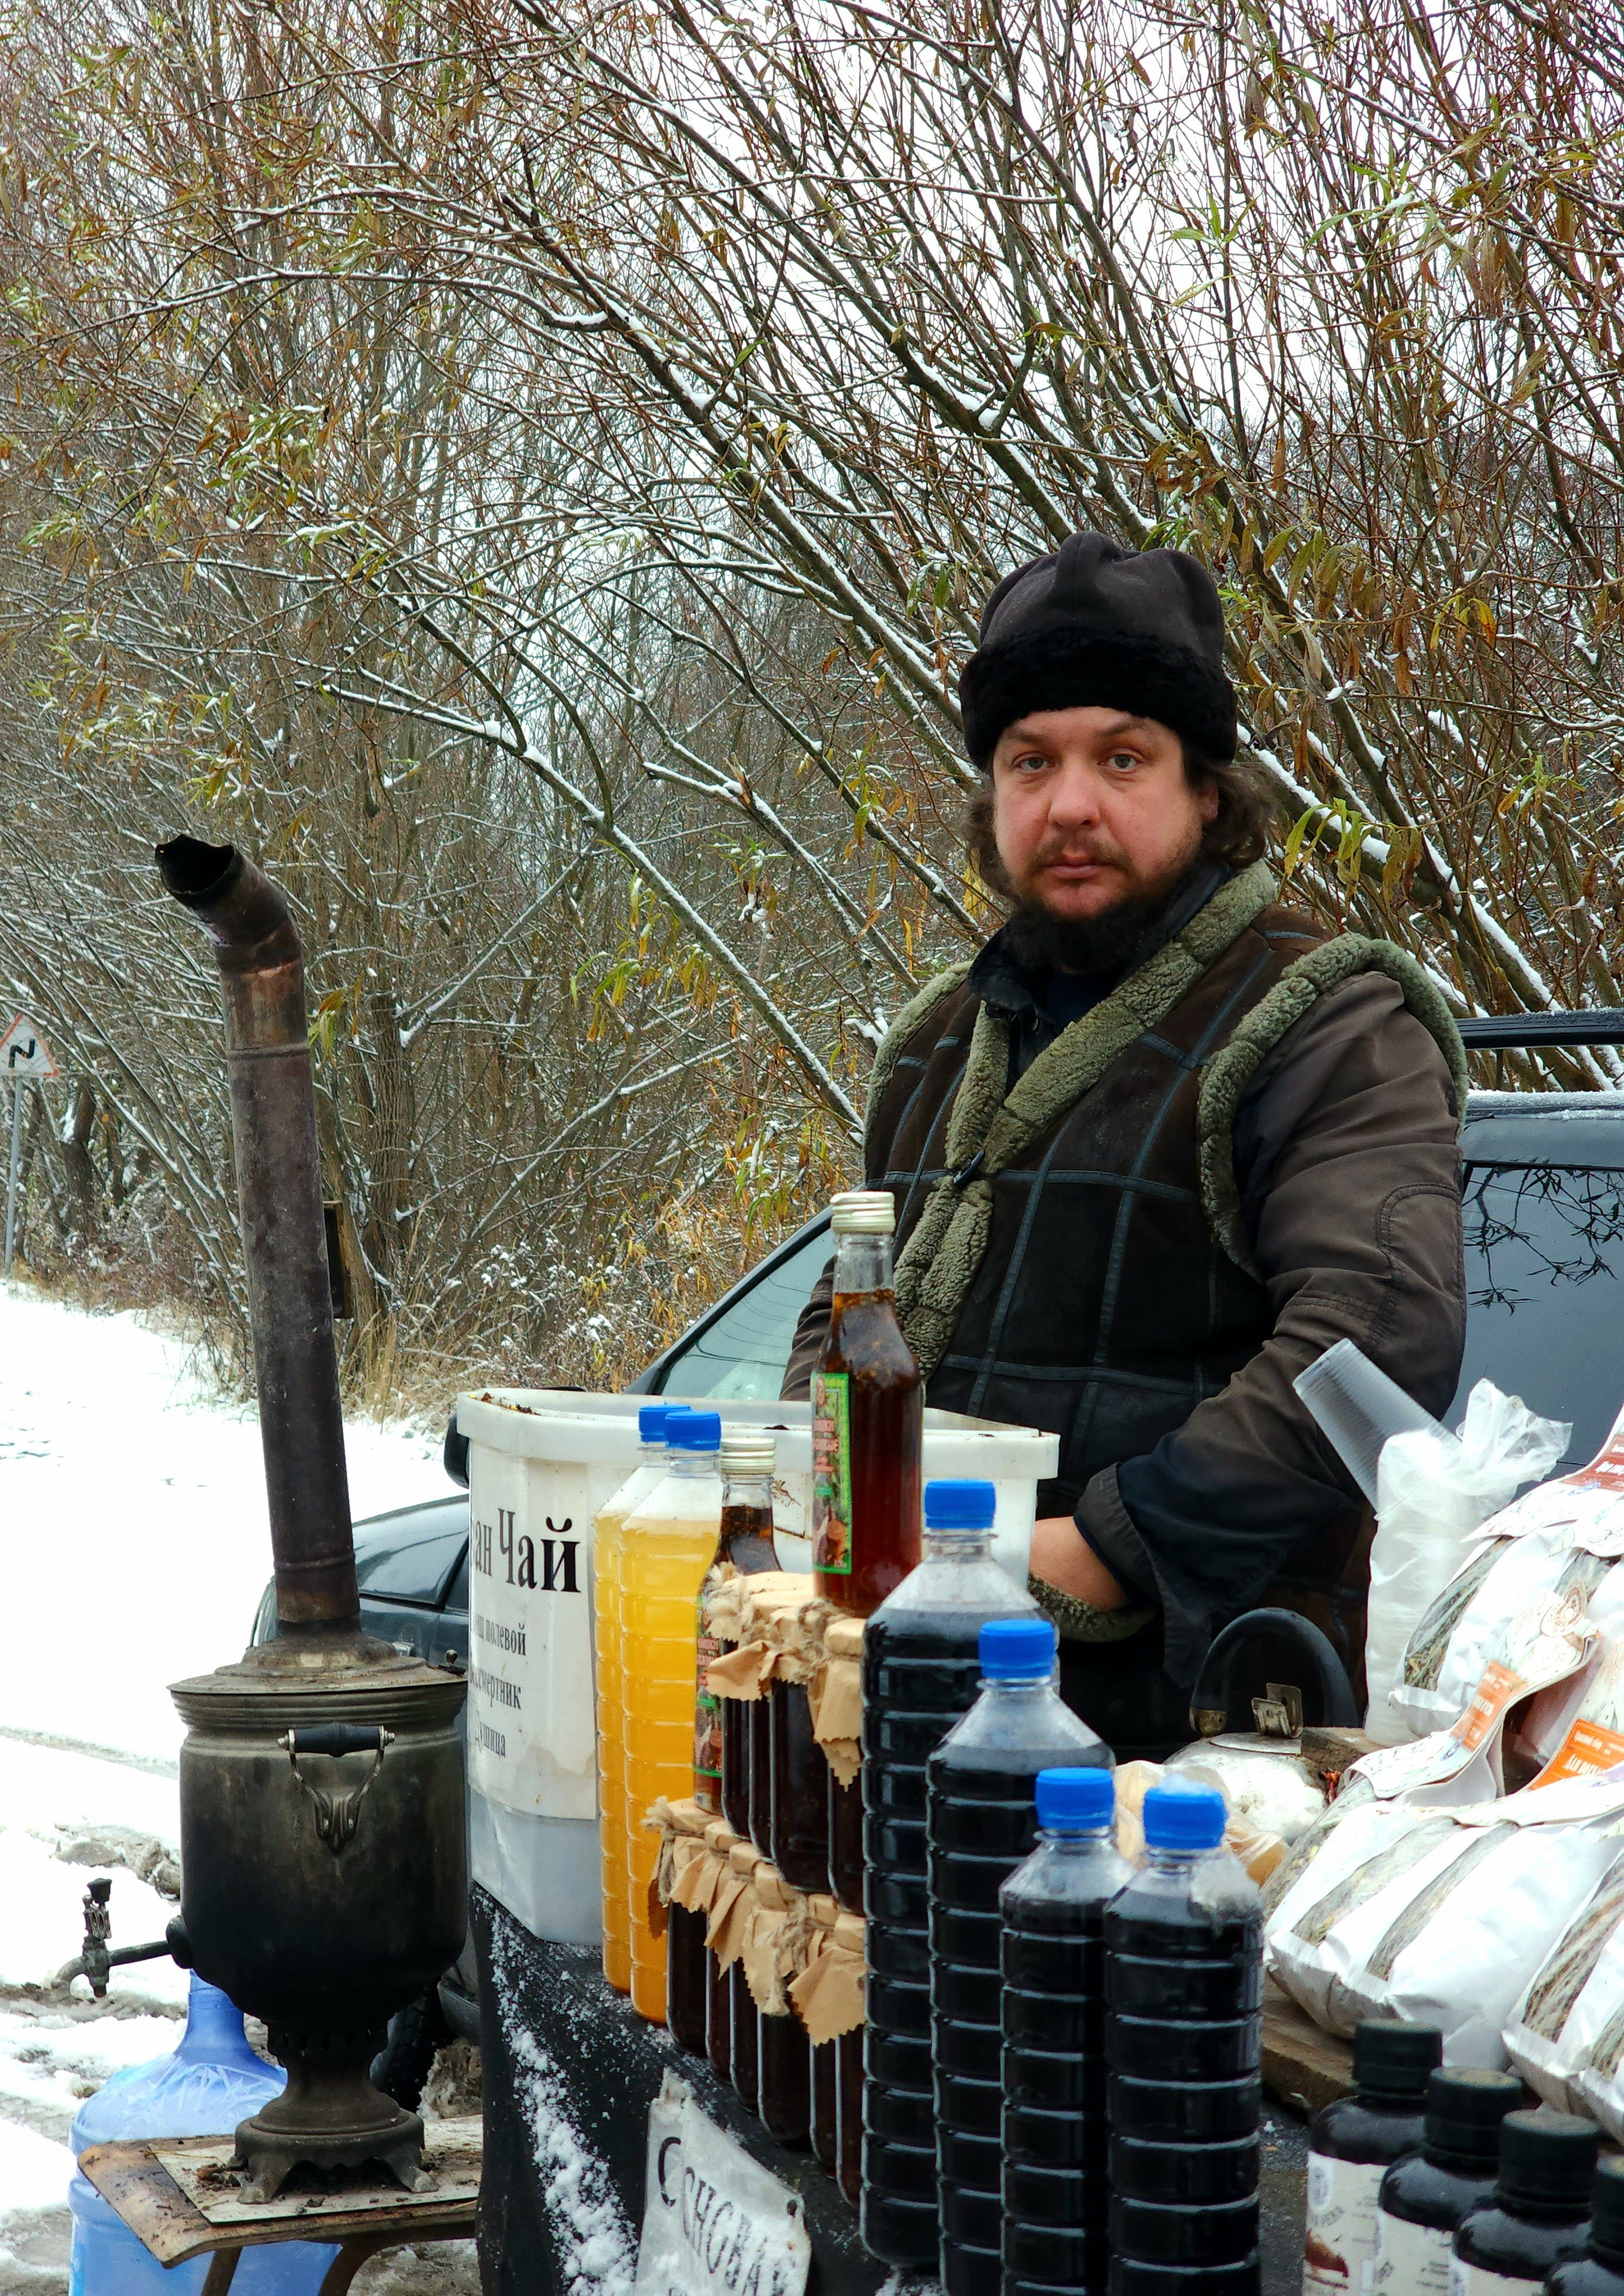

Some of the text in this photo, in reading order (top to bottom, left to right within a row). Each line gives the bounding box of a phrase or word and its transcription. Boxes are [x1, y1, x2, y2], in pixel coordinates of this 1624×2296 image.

[475, 1507, 581, 1594] ан Чай
[486, 1619, 527, 1656] полевой
